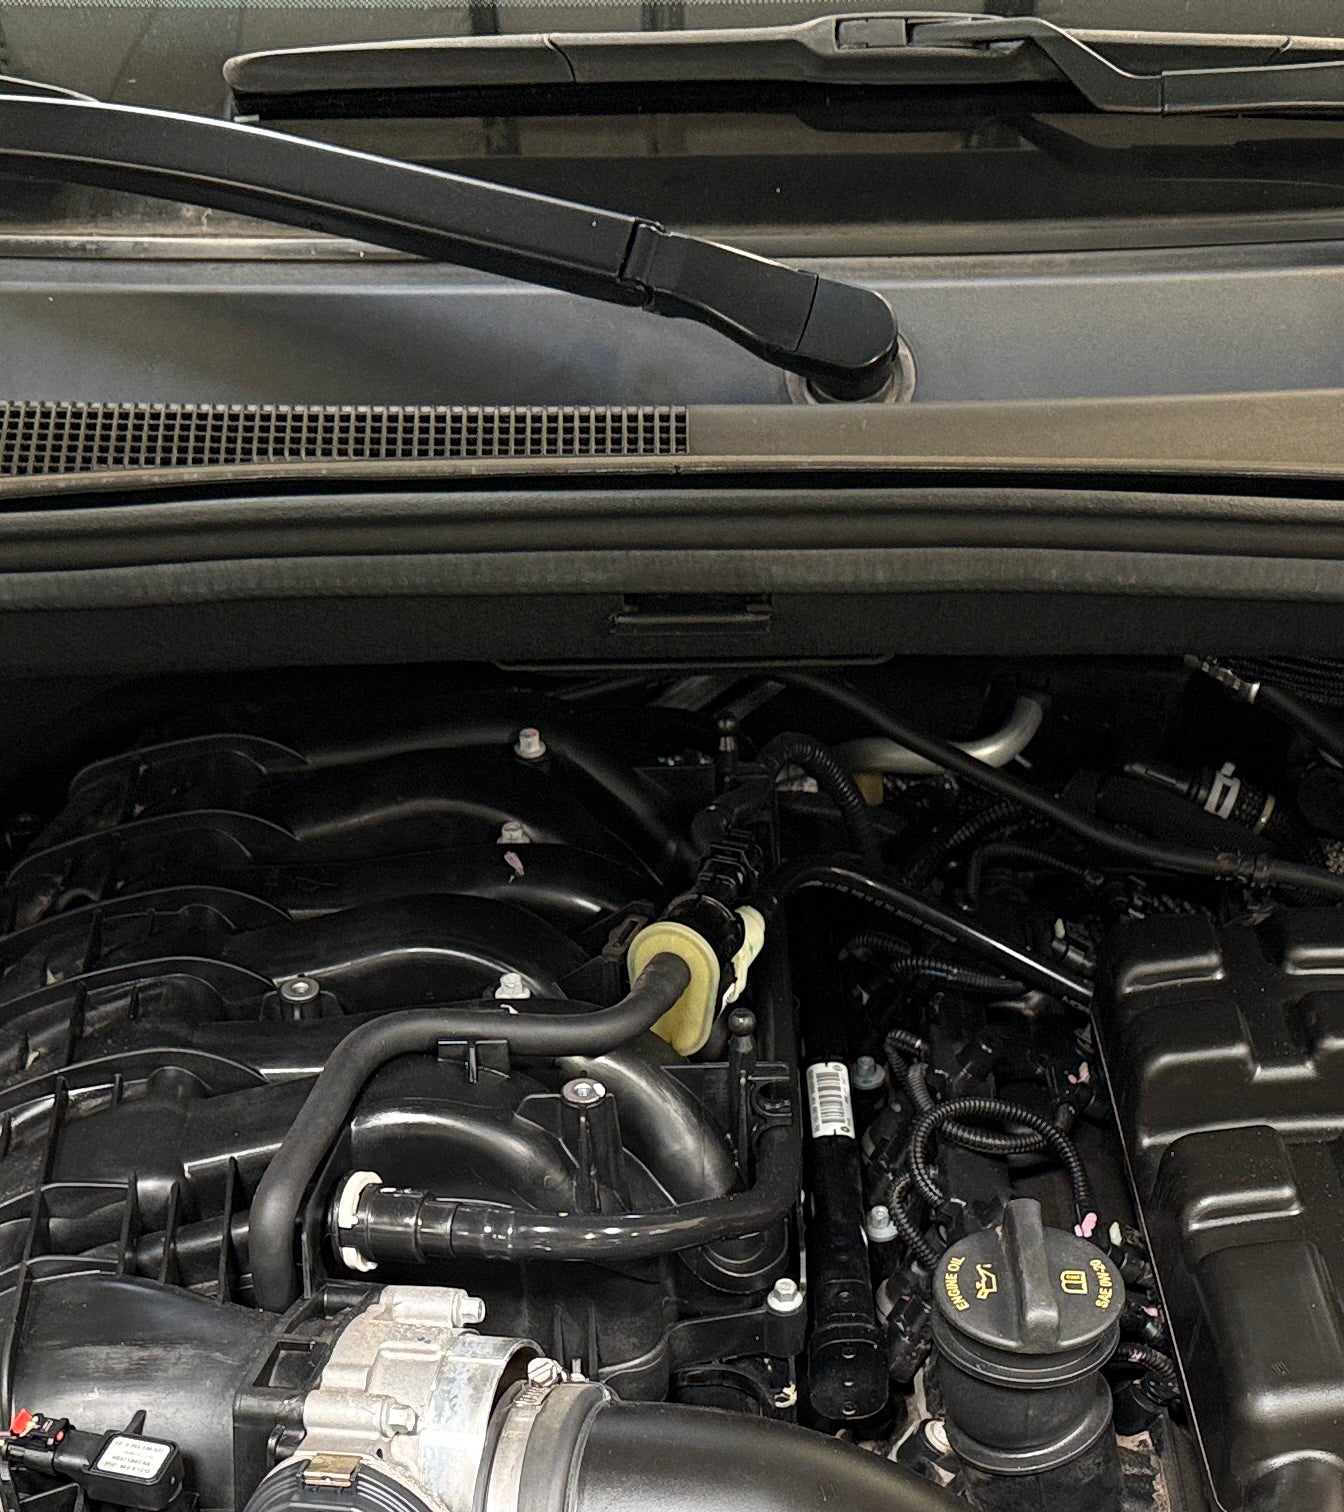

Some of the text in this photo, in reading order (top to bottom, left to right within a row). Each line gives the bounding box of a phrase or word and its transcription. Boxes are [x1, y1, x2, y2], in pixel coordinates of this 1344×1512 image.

[945, 1256, 970, 1311] ENGINE OIL
[1095, 1287, 1113, 1309] SAE
